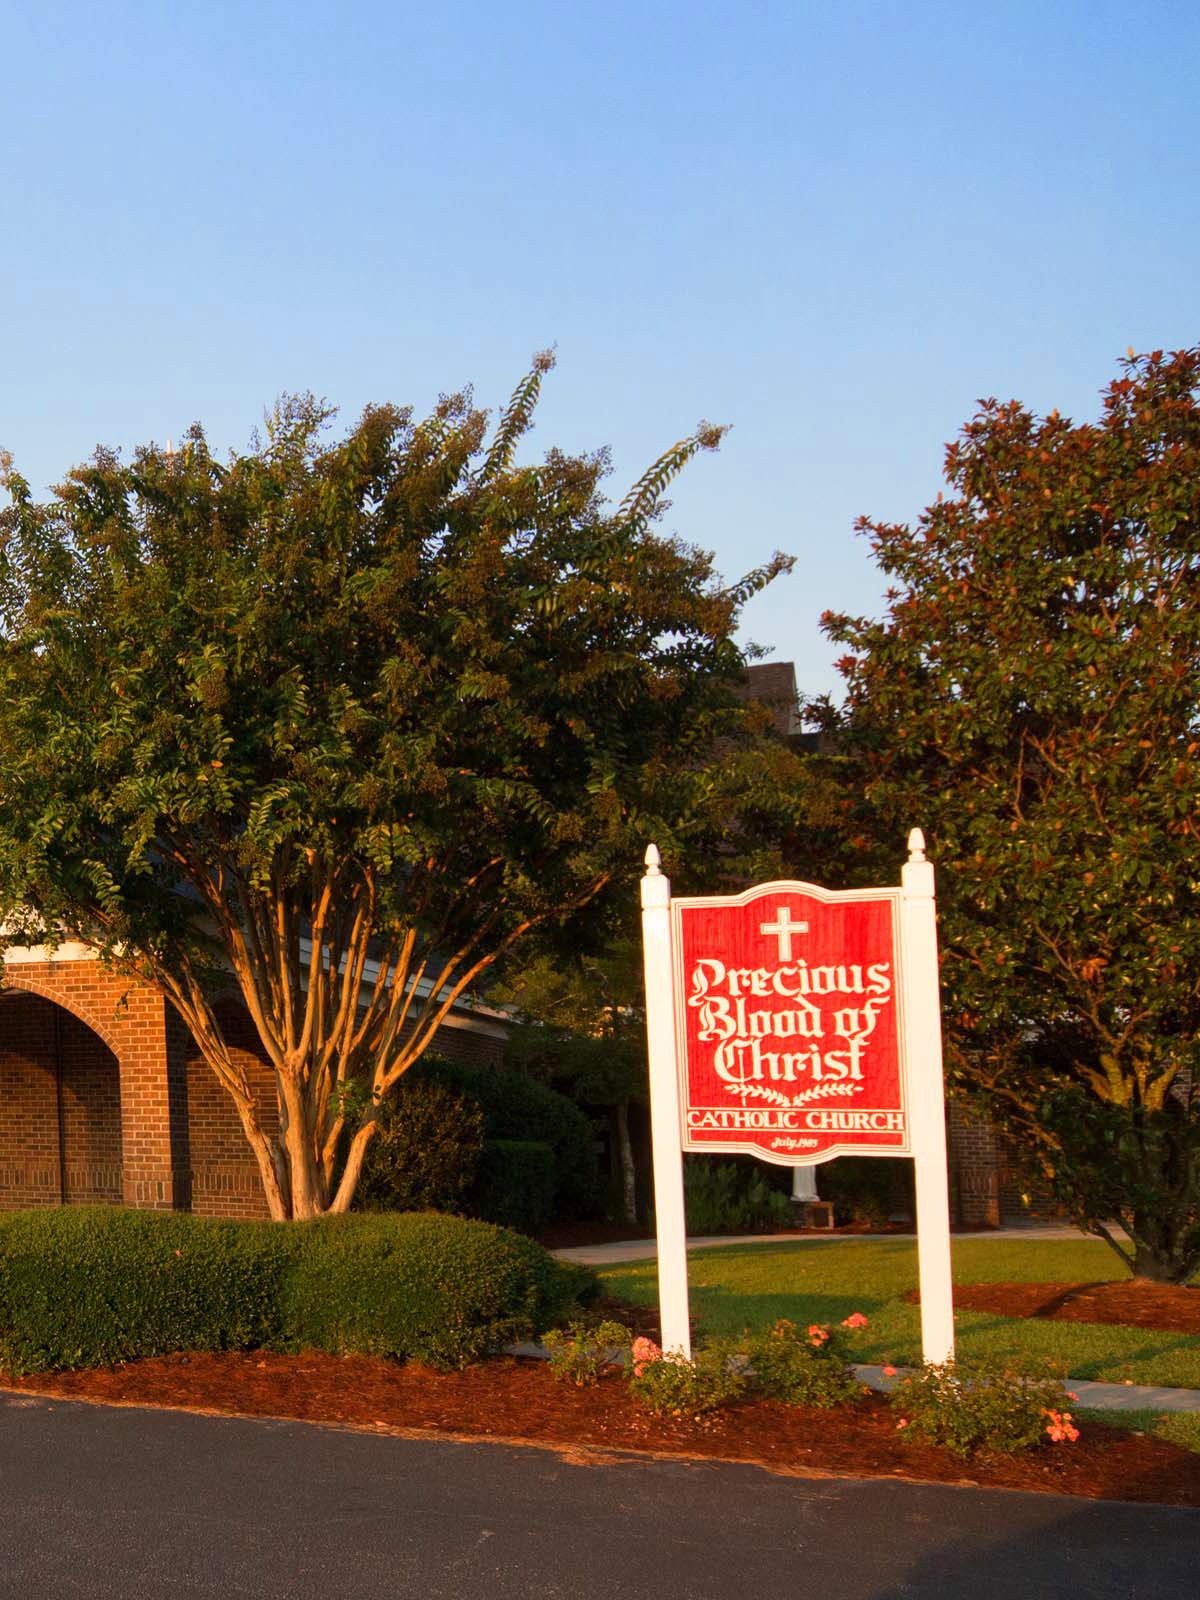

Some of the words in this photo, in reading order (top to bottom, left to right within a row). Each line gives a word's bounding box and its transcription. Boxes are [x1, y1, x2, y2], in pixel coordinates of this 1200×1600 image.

[688, 959, 891, 1006] Precious
[698, 995, 825, 1041] Blood
[833, 997, 890, 1040] of
[714, 1037, 870, 1083] Christ
[687, 1111, 798, 1127] CATHOLIC
[806, 1112, 904, 1129] CHURCH
